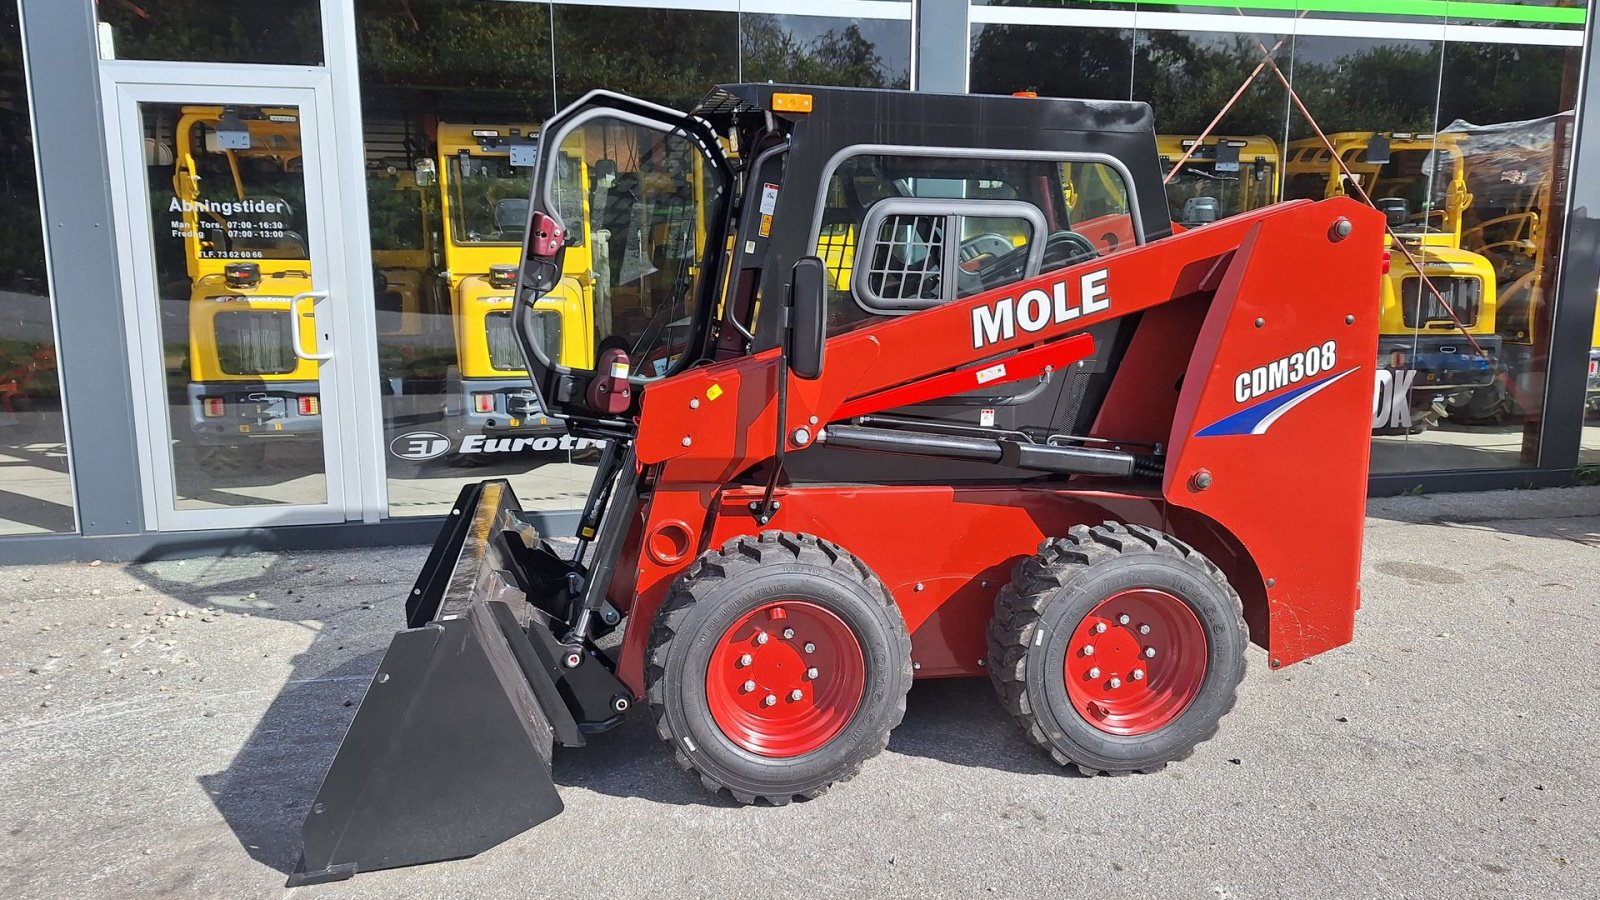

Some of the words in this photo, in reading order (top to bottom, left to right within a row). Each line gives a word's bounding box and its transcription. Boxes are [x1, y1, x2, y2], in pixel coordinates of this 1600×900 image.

[171, 221, 190, 229] Man
[200, 221, 223, 229] Tors.
[172, 230, 205, 238] Fredag
[228, 230, 252, 238] 07:00
[259, 230, 284, 238] 13:00
[972, 267, 1110, 350] MOLE
[1234, 339, 1337, 404] CDM308
